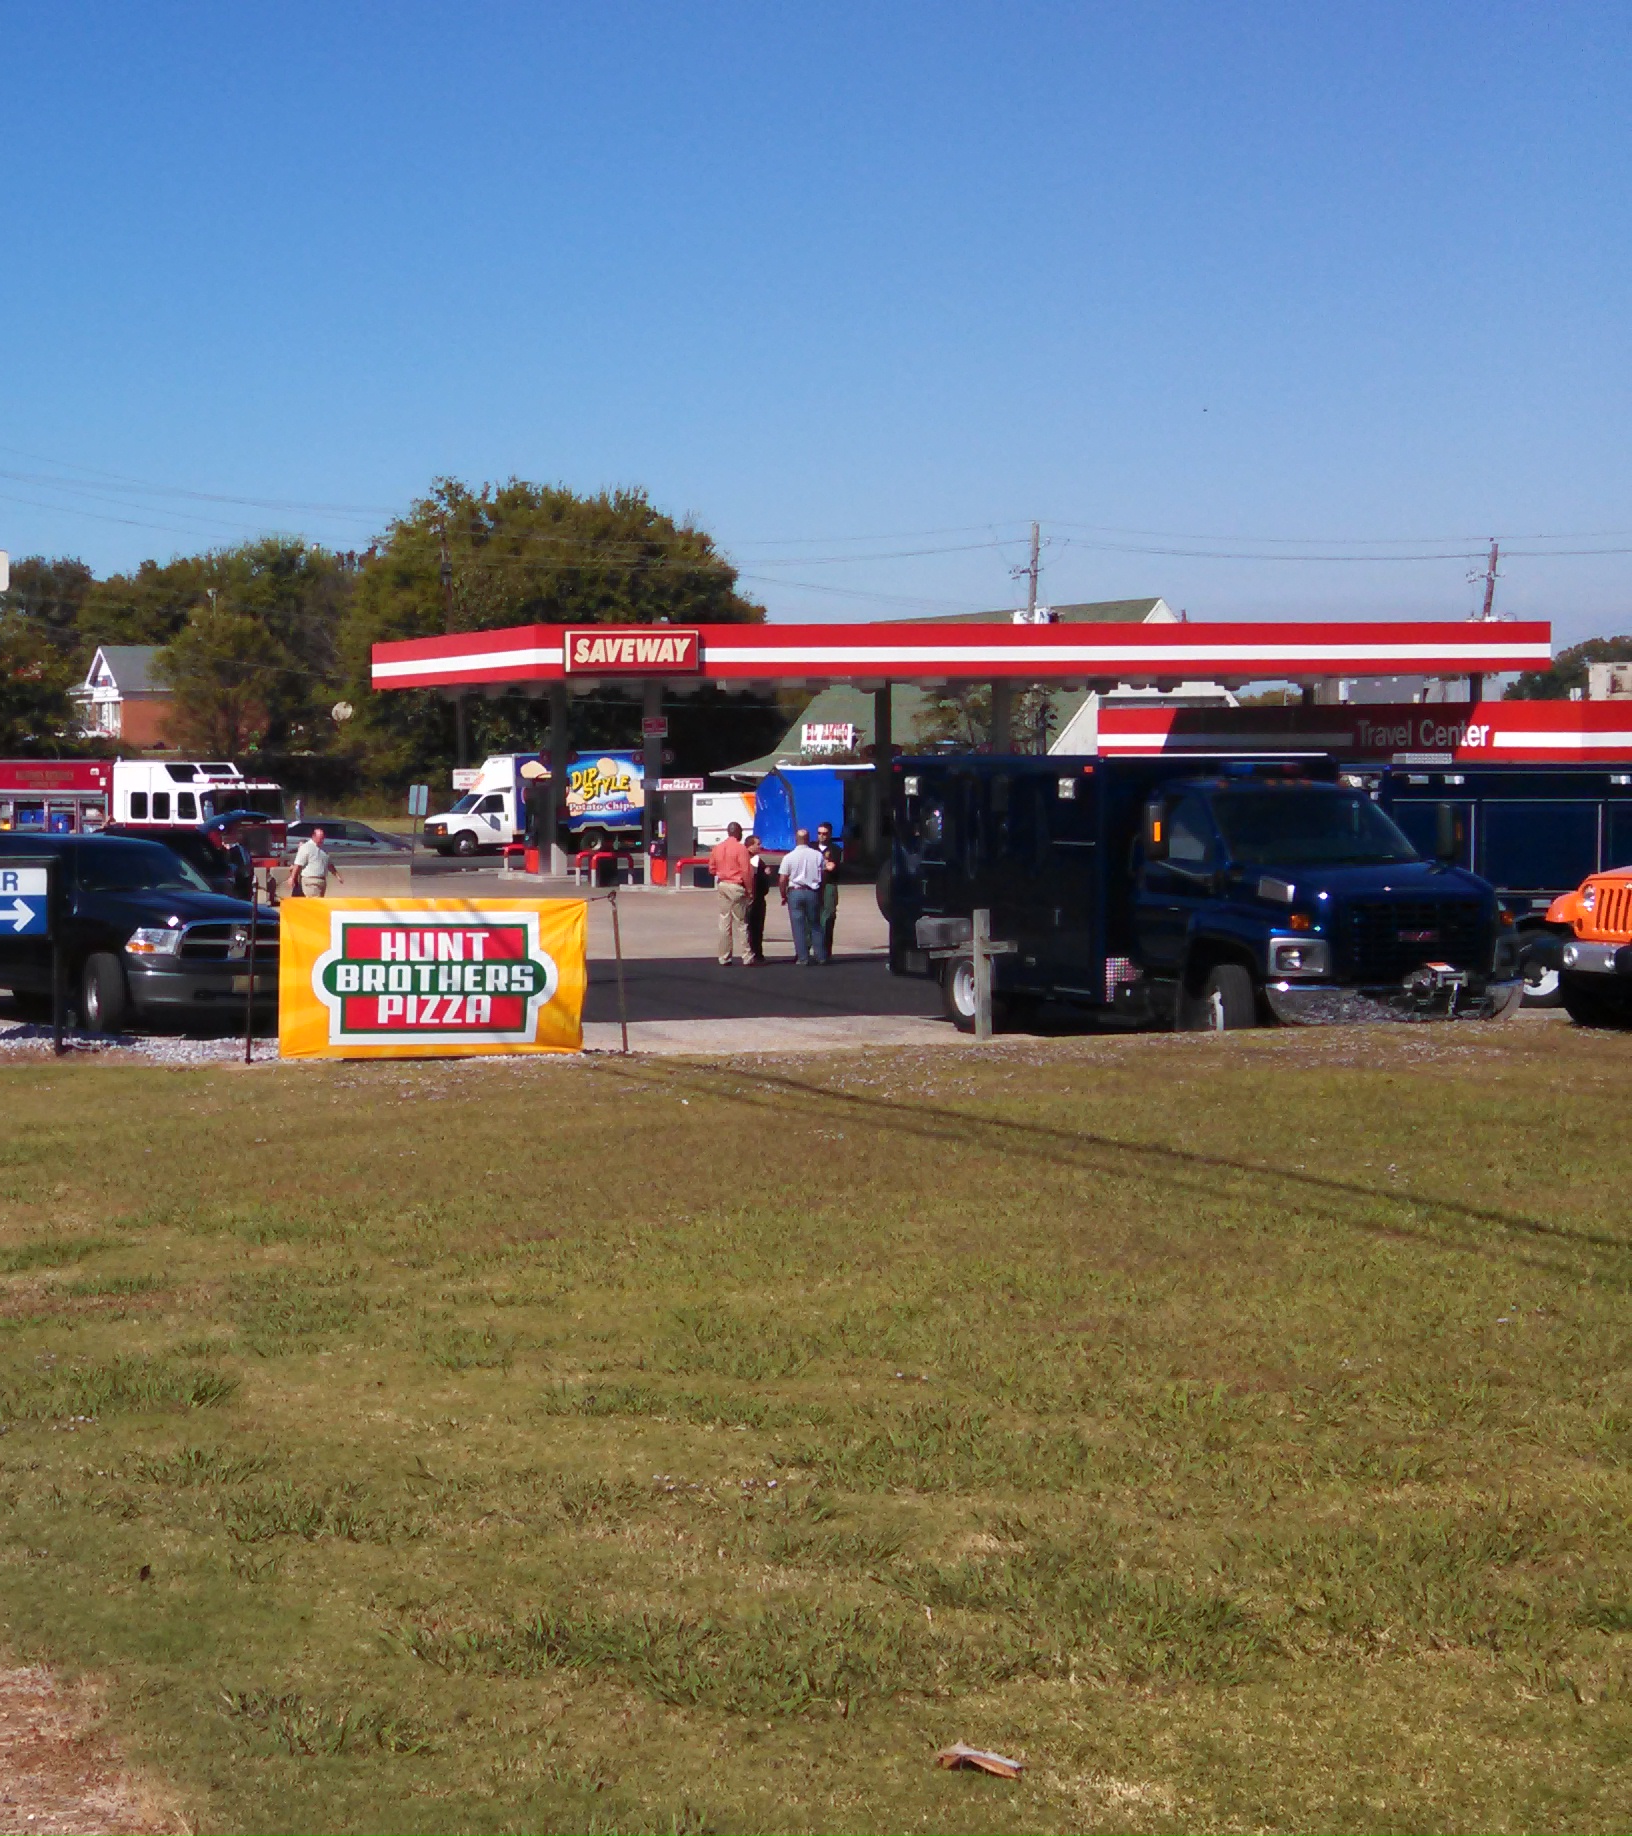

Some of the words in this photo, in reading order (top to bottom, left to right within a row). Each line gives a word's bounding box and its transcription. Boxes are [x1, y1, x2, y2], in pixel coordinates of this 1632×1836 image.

[574, 638, 691, 663] SAVEWAY
[1357, 719, 1413, 747] Travel
[1419, 719, 1490, 747] Center
[571, 767, 599, 792] DIP
[583, 775, 631, 801] STYLE
[569, 802, 603, 812] Potato
[605, 800, 635, 812] Chips
[381, 932, 490, 961] HUNT
[336, 964, 534, 992] BROTHERS
[377, 995, 492, 1024] PIZZA
